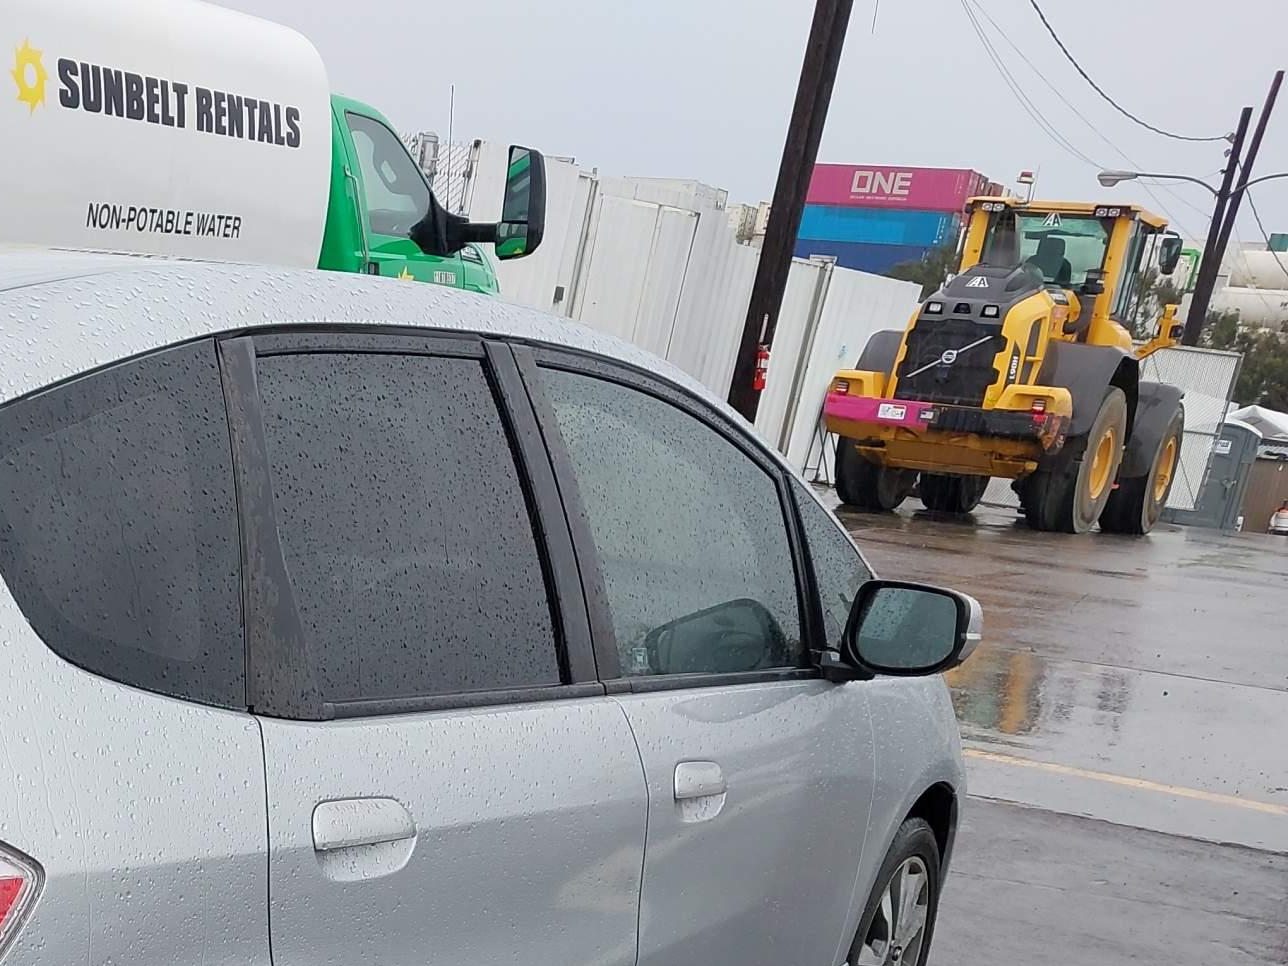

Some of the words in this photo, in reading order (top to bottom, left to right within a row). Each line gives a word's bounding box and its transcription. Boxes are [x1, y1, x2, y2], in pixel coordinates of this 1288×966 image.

[57, 57, 188, 128] SUNBELT
[195, 86, 301, 149] RENTALS
[851, 171, 913, 195] ONE
[86, 202, 194, 235] NON-POTABLE
[195, 212, 242, 238] WATER
